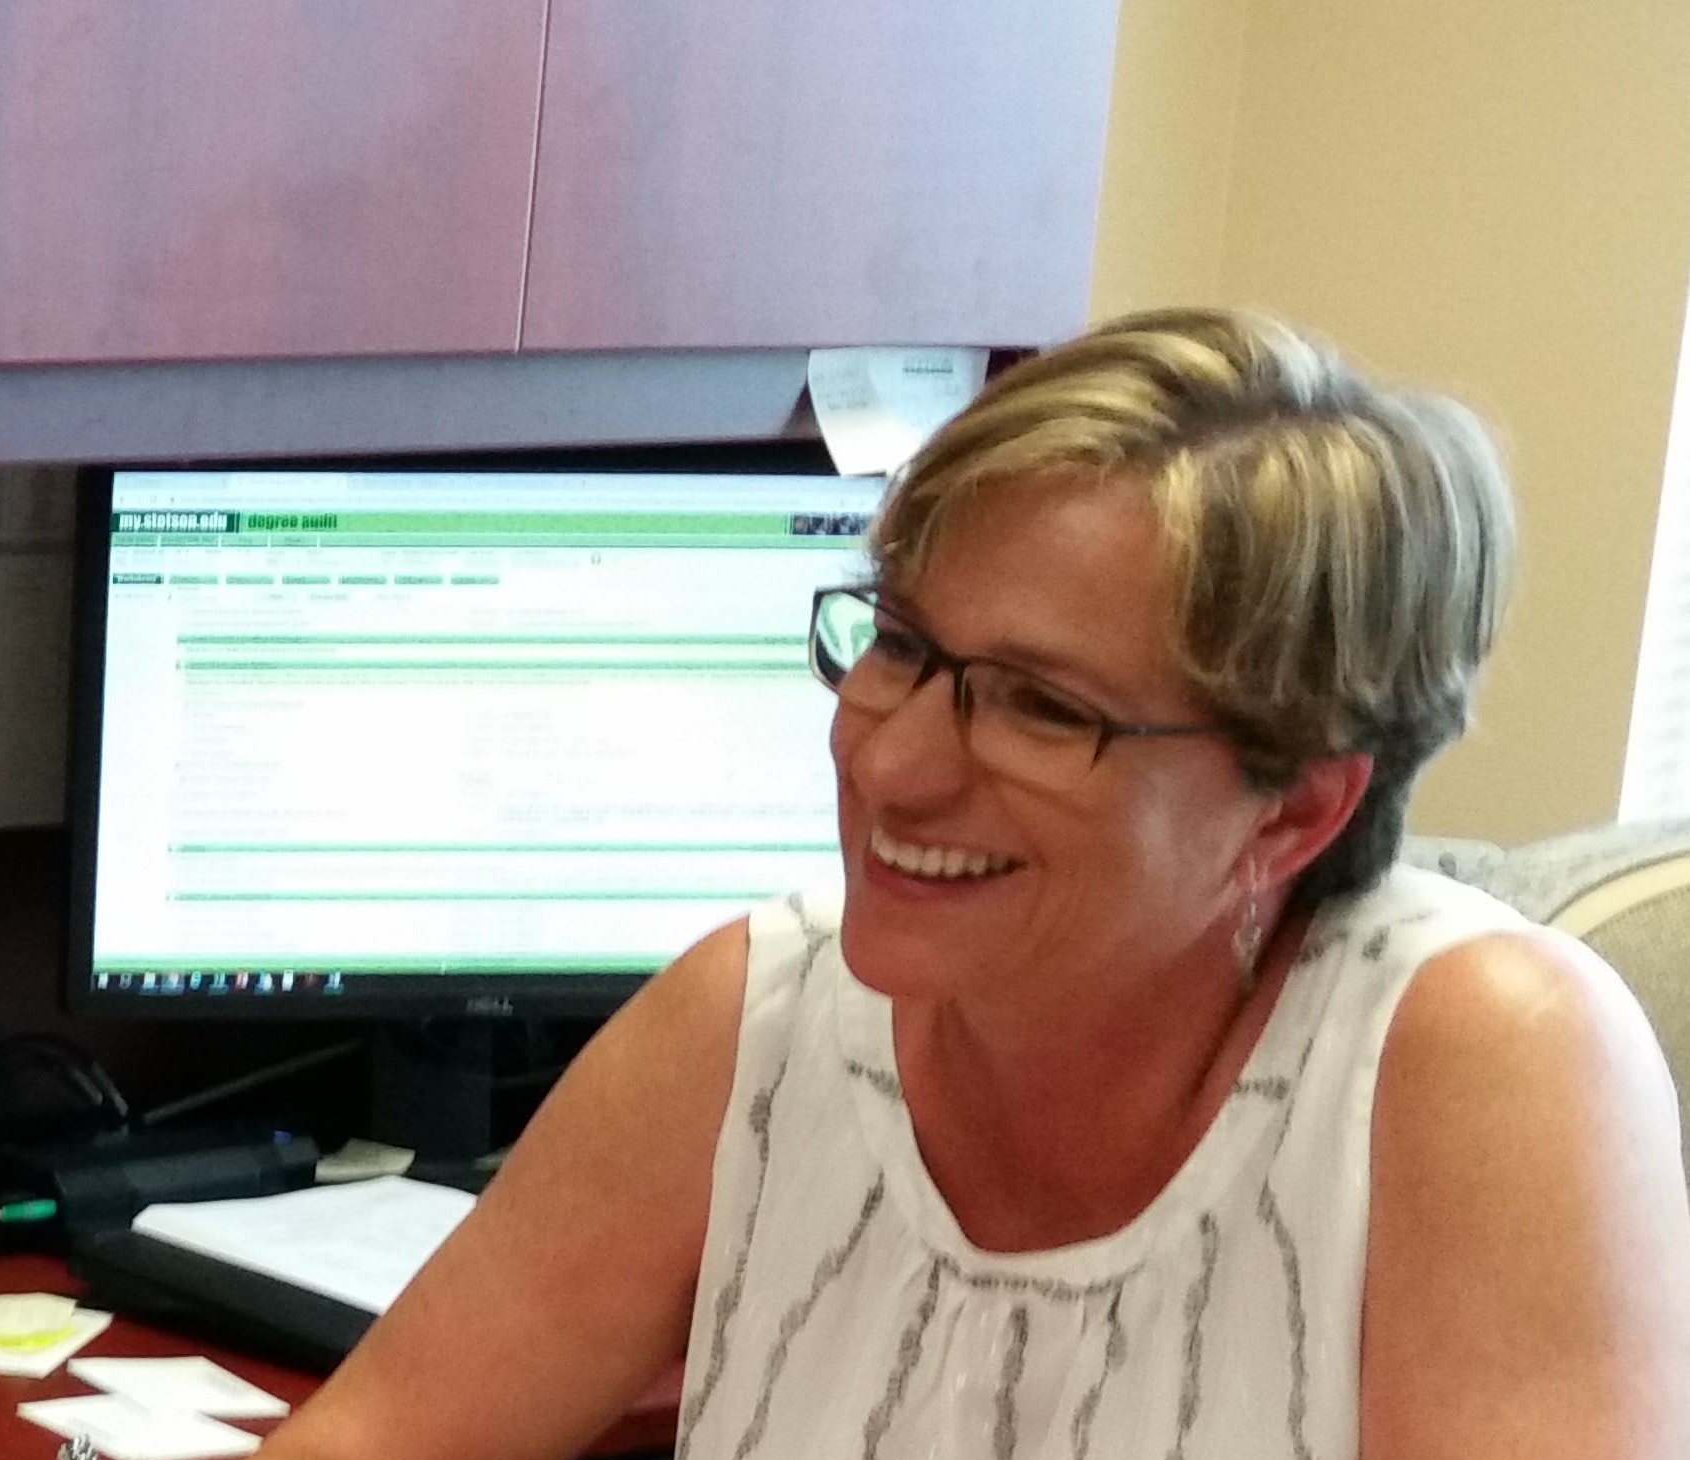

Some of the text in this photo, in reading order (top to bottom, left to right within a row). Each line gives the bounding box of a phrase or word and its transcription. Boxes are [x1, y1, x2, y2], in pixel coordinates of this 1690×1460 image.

[118, 511, 339, 532] my.stetson.edu degree audit
